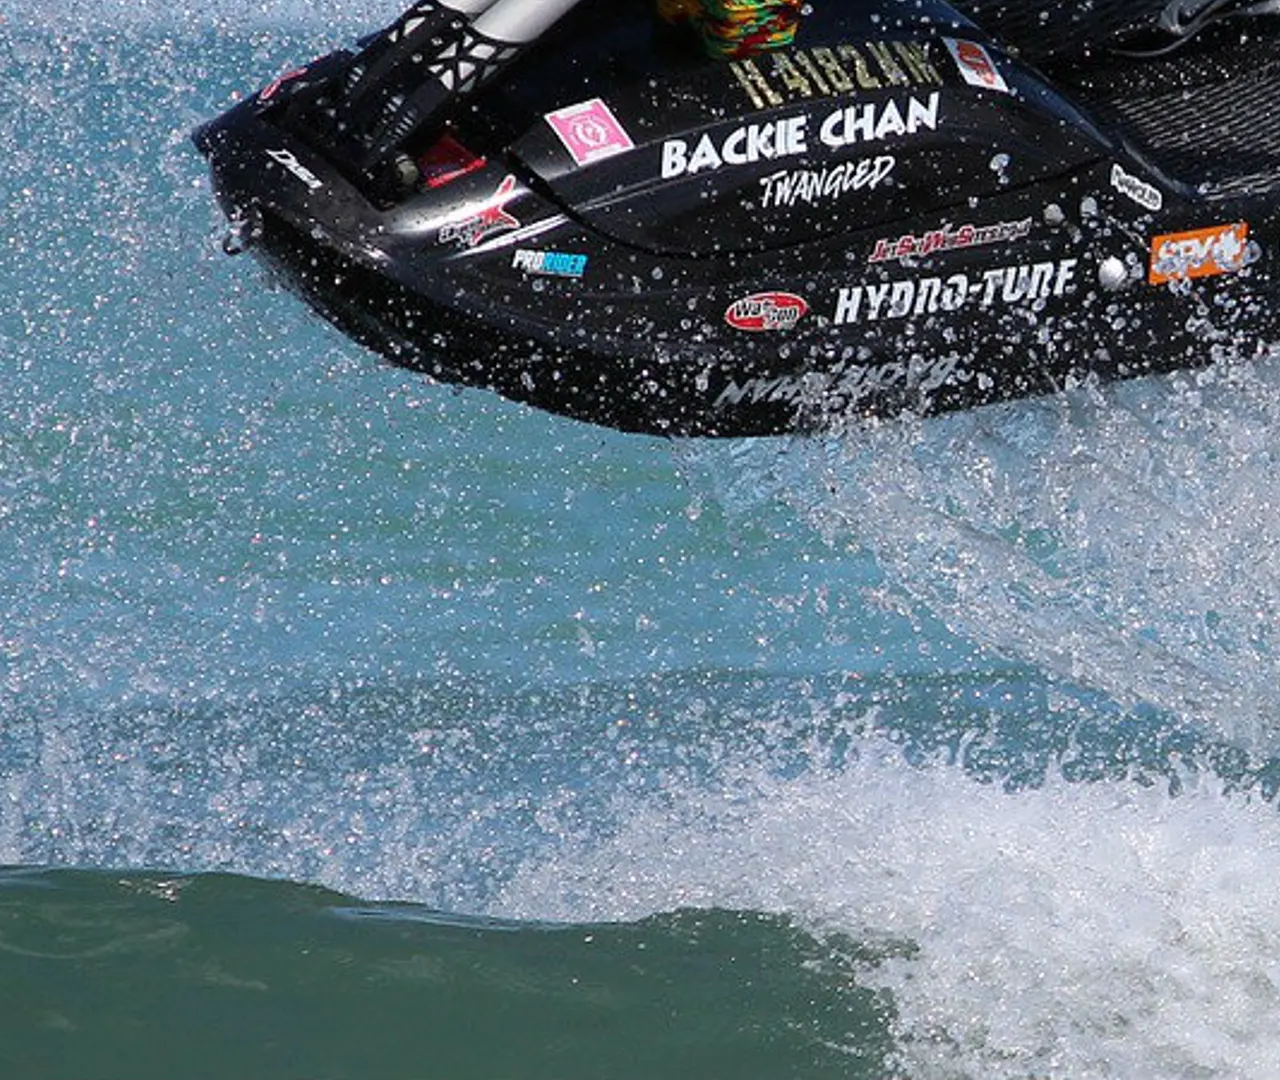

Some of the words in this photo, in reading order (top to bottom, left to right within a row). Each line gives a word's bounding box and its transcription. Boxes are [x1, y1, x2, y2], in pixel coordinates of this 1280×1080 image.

[661, 116, 808, 179] BACKIE
[820, 92, 940, 147] CHAN
[759, 156, 896, 208] TWANGLED
[834, 259, 1078, 325] HYDRO-TURF
